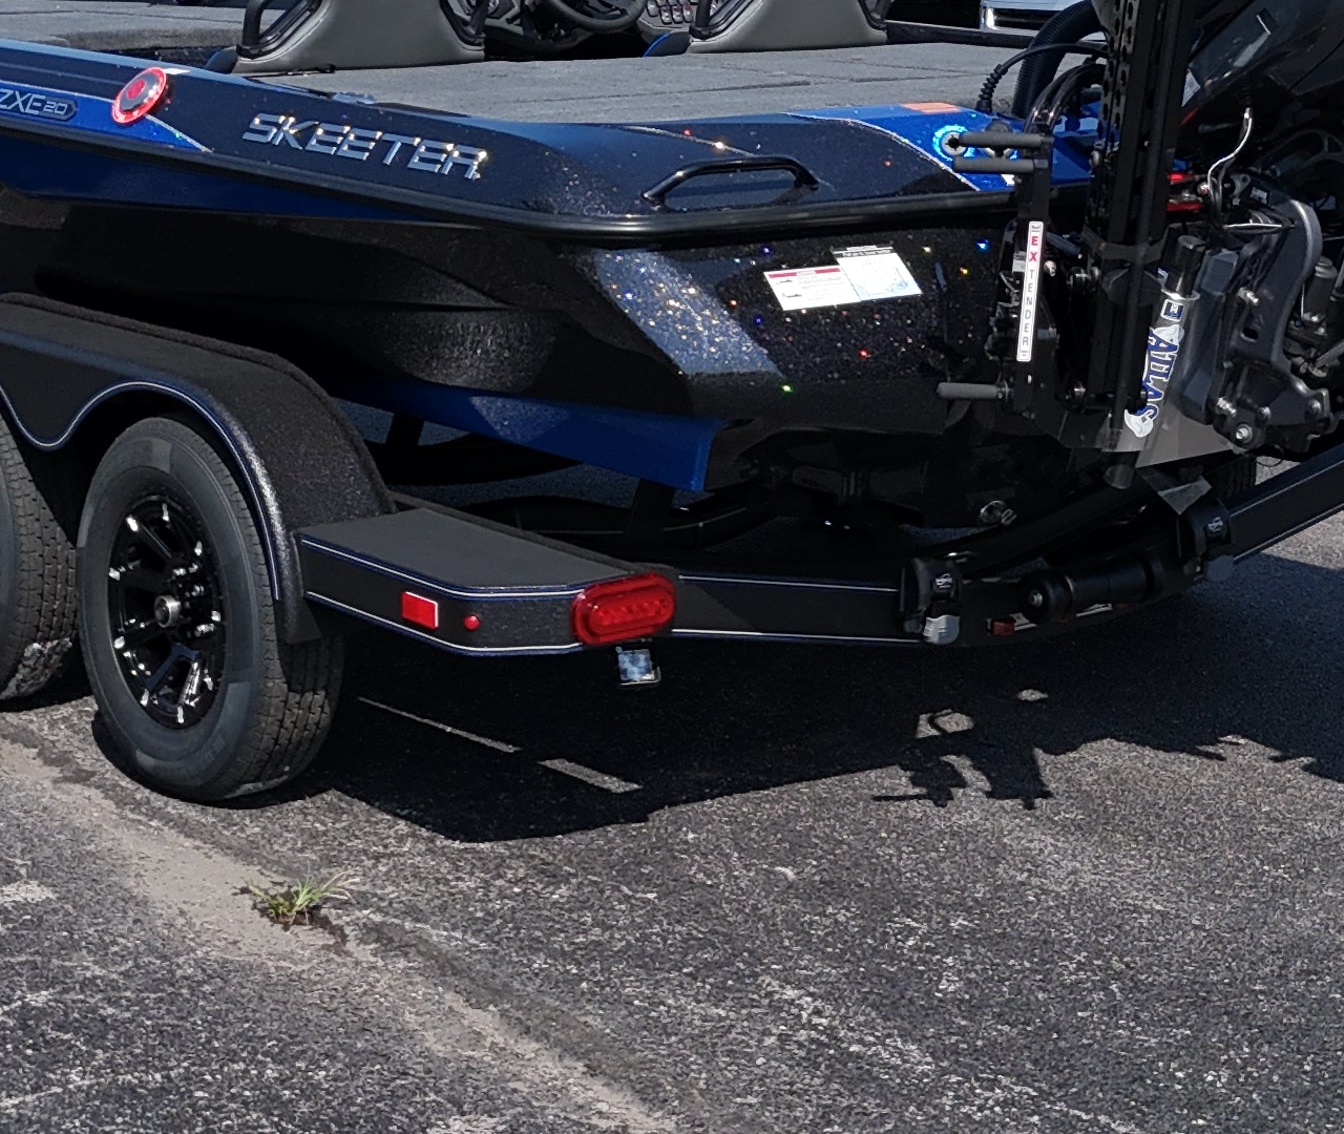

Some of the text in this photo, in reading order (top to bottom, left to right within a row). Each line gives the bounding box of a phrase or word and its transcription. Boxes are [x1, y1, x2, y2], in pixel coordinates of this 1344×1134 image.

[242, 112, 486, 180] SKEETER
[1021, 235, 1039, 347] EXTENDER
[1135, 328, 1180, 420] ATLAS
